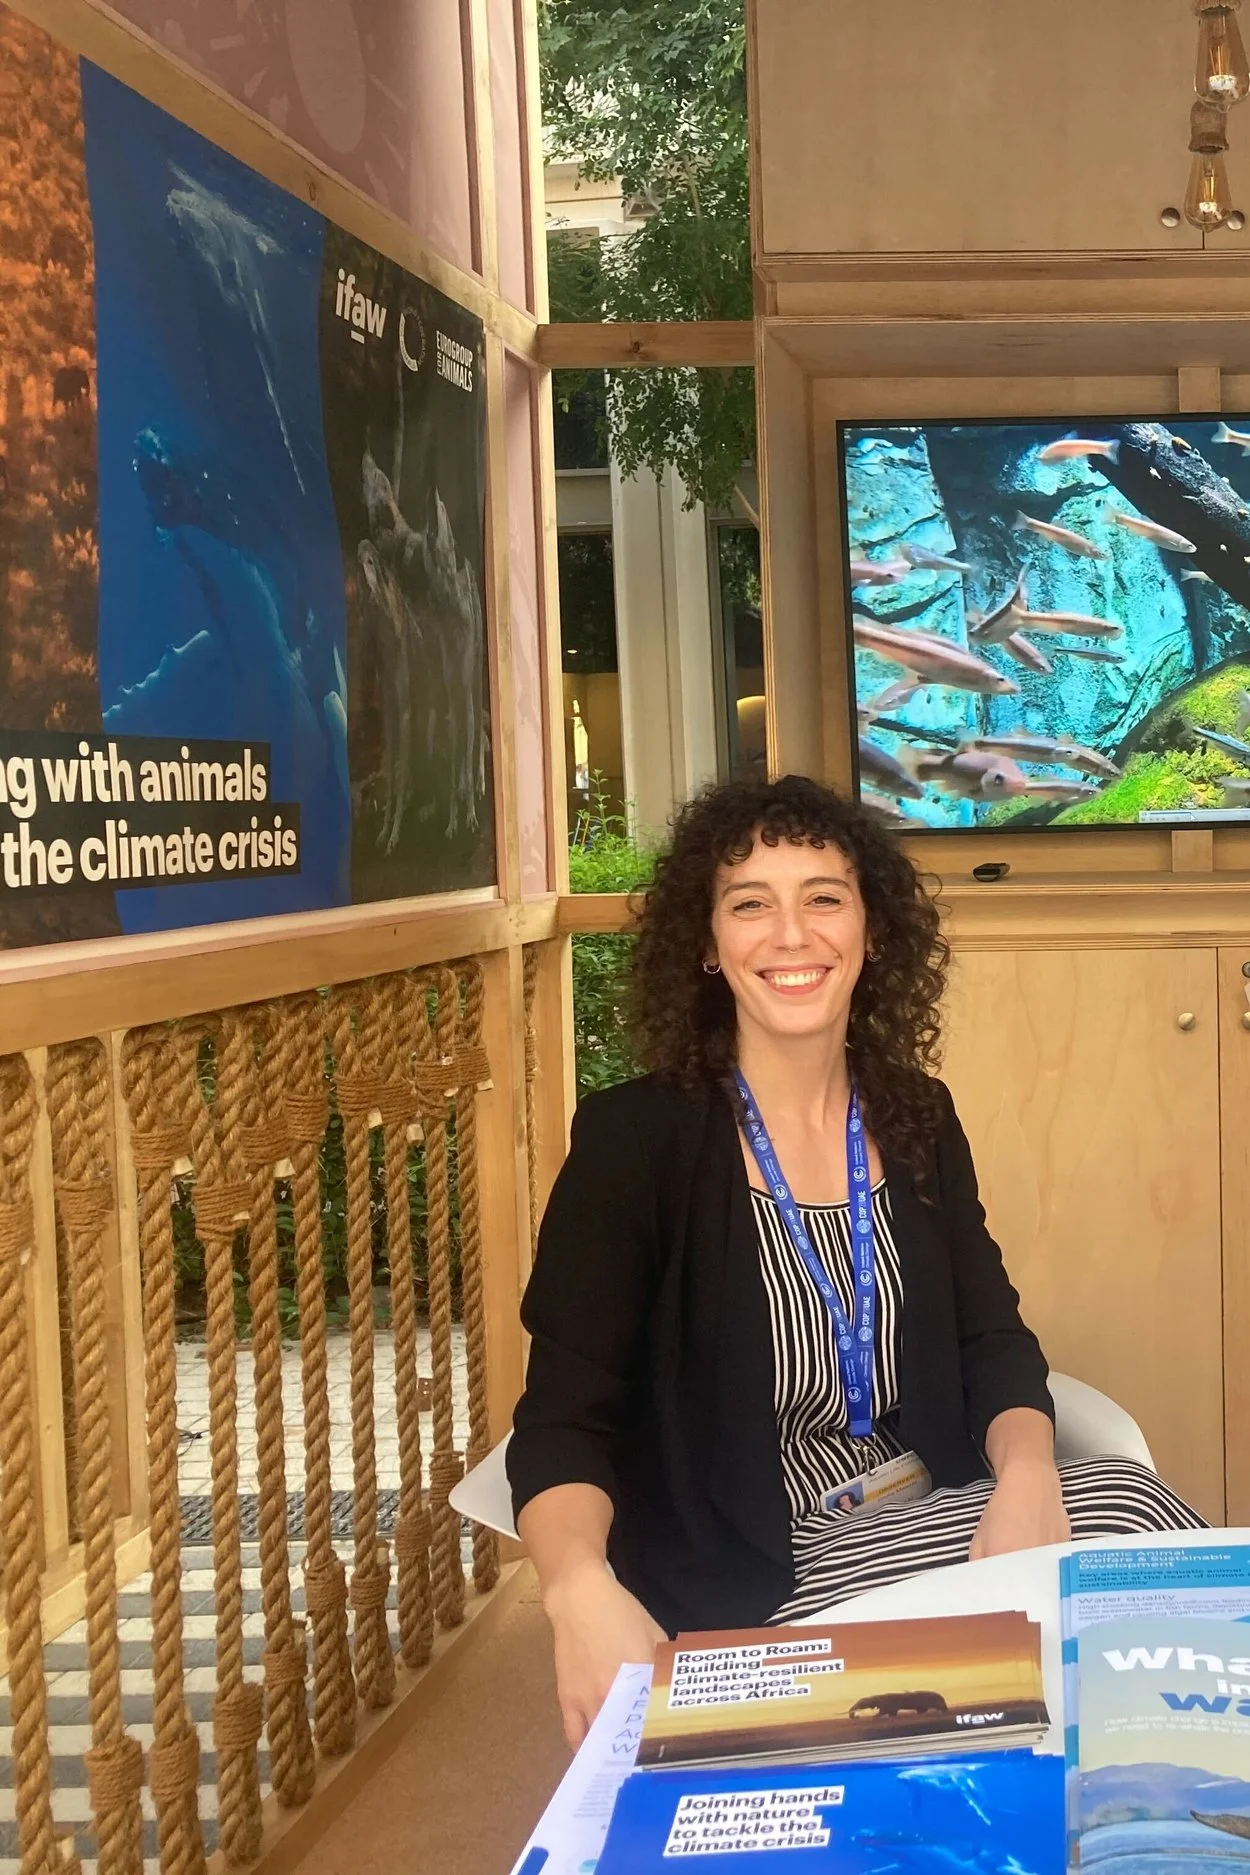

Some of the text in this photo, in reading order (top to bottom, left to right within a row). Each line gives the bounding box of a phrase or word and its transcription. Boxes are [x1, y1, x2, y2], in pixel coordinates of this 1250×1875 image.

[335, 268, 387, 339] ifaw
[437, 330, 473, 368] EUROGROUP
[442, 354, 473, 392] ANIMALS
[41, 741, 134, 803] with
[140, 745, 267, 802] animals
[1, 815, 298, 888] the climate crisis
[1079, 1549, 1185, 1559] Aquatic Animal
[1079, 1556, 1133, 1564] Welfare
[1152, 1553, 1231, 1562] Sustainable
[1079, 1562, 1174, 1570] Development
[1126, 1594, 1175, 1602] quality
[677, 1643, 829, 1664] Room to Roam:
[674, 1662, 842, 1686] climate-resilient
[676, 1660, 761, 1675] Building
[671, 1686, 809, 1707] across Africa
[673, 1678, 792, 1697] landscapes
[956, 1712, 1004, 1724] ifaw
[680, 1789, 840, 1811] Joining hands
[678, 1807, 810, 1825] with nature
[673, 1820, 818, 1839] to tackle the
[668, 1833, 825, 1853] climate crisis
